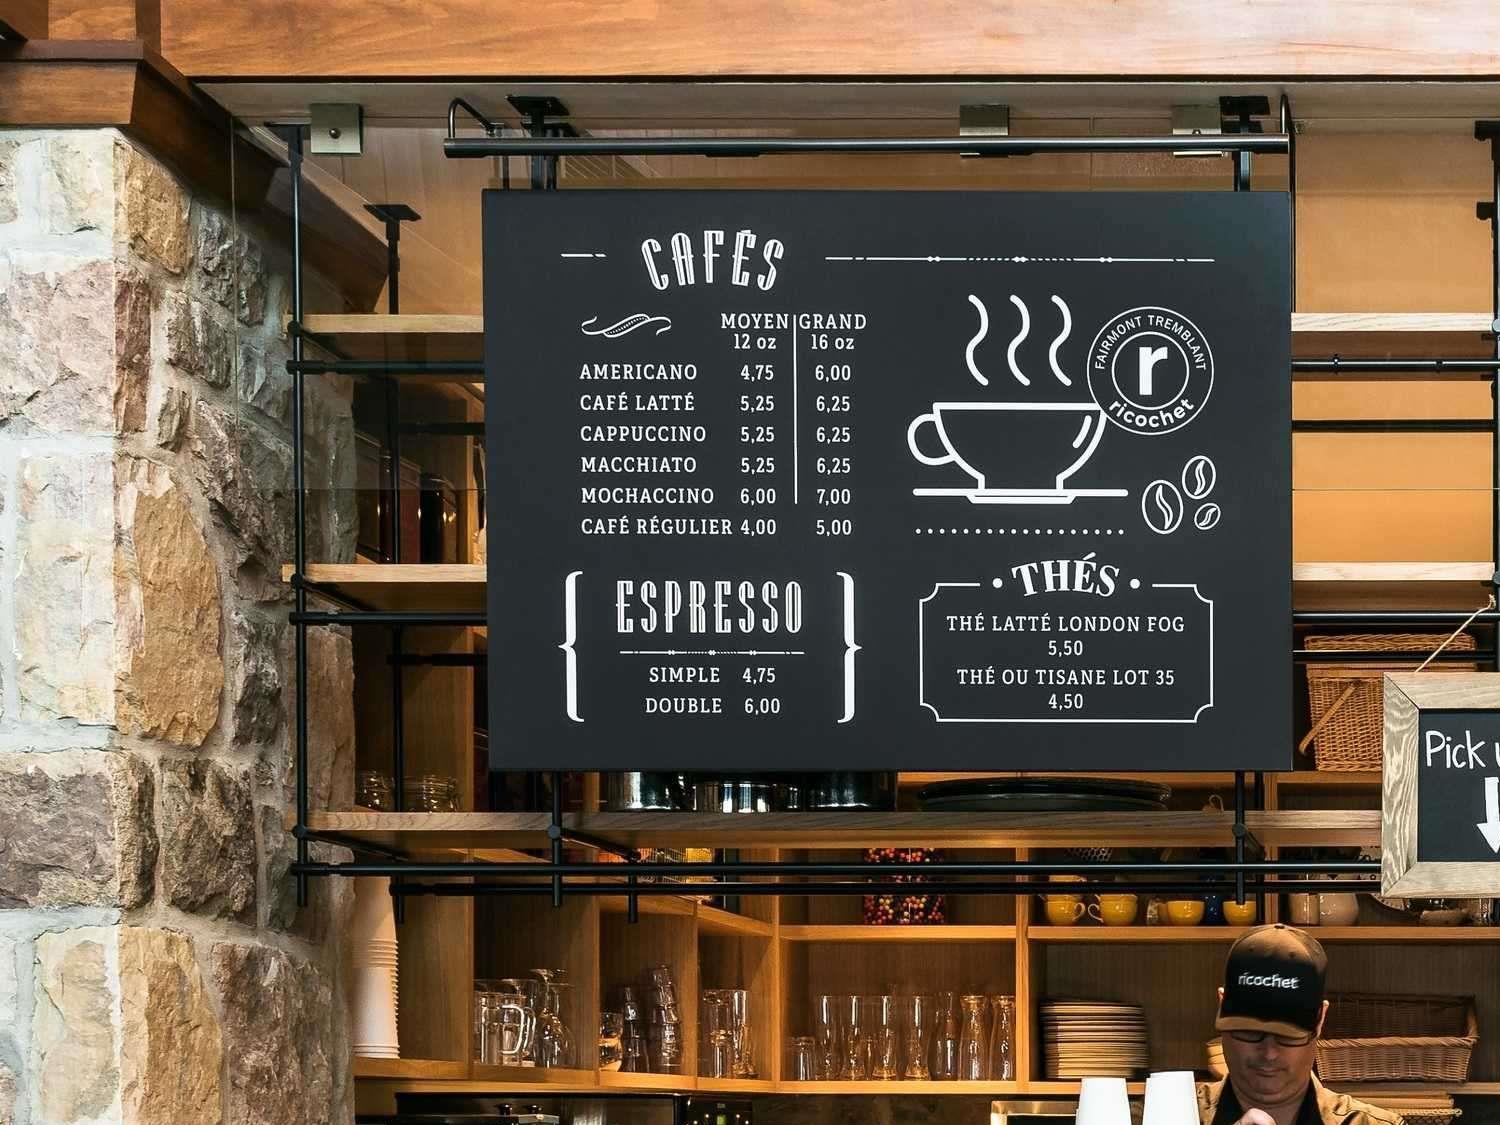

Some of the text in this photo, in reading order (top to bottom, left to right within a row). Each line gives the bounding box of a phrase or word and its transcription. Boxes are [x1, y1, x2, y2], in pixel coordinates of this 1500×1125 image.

[642, 230, 784, 290] CAFÉS
[721, 313, 788, 329] MOYEN
[799, 314, 866, 329] GRAND
[734, 334, 776, 349] 12 oz
[812, 334, 854, 349] 16 oz
[1095, 315, 1206, 371] FAIRMONT TREMBLANT
[580, 364, 850, 382] AMERICANO 4,75 6,00
[1139, 346, 1168, 396] r
[581, 392, 850, 413] CAFÉ LATTÉ 5,25 6,25
[1108, 398, 1194, 427] ricochet
[581, 426, 850, 444] CAPPUCCINO 5,25 6,25
[581, 457, 850, 475] MACCHIATO 5,25 6,25
[582, 488, 850, 505] MOCHACCINO 6,00 7,00
[582, 515, 851, 536] CAFÉ RÉGULIER 4,00 5,00
[1012, 552, 1119, 596] THÉS
[616, 581, 801, 633] ESPRESSO
[947, 613, 1184, 632] THÉ LATTÉ LONDON FOG
[1049, 640, 1082, 657] 5,50
[650, 667, 775, 684] SIMPLE 4,75
[957, 666, 1174, 685] THÉ OU TISANE LOT 35
[646, 698, 780, 715] DOUBLE 6,00
[1049, 694, 1083, 710] 4,50
[1425, 730, 1486, 770] Pick
[1239, 972, 1300, 989] ricochet
